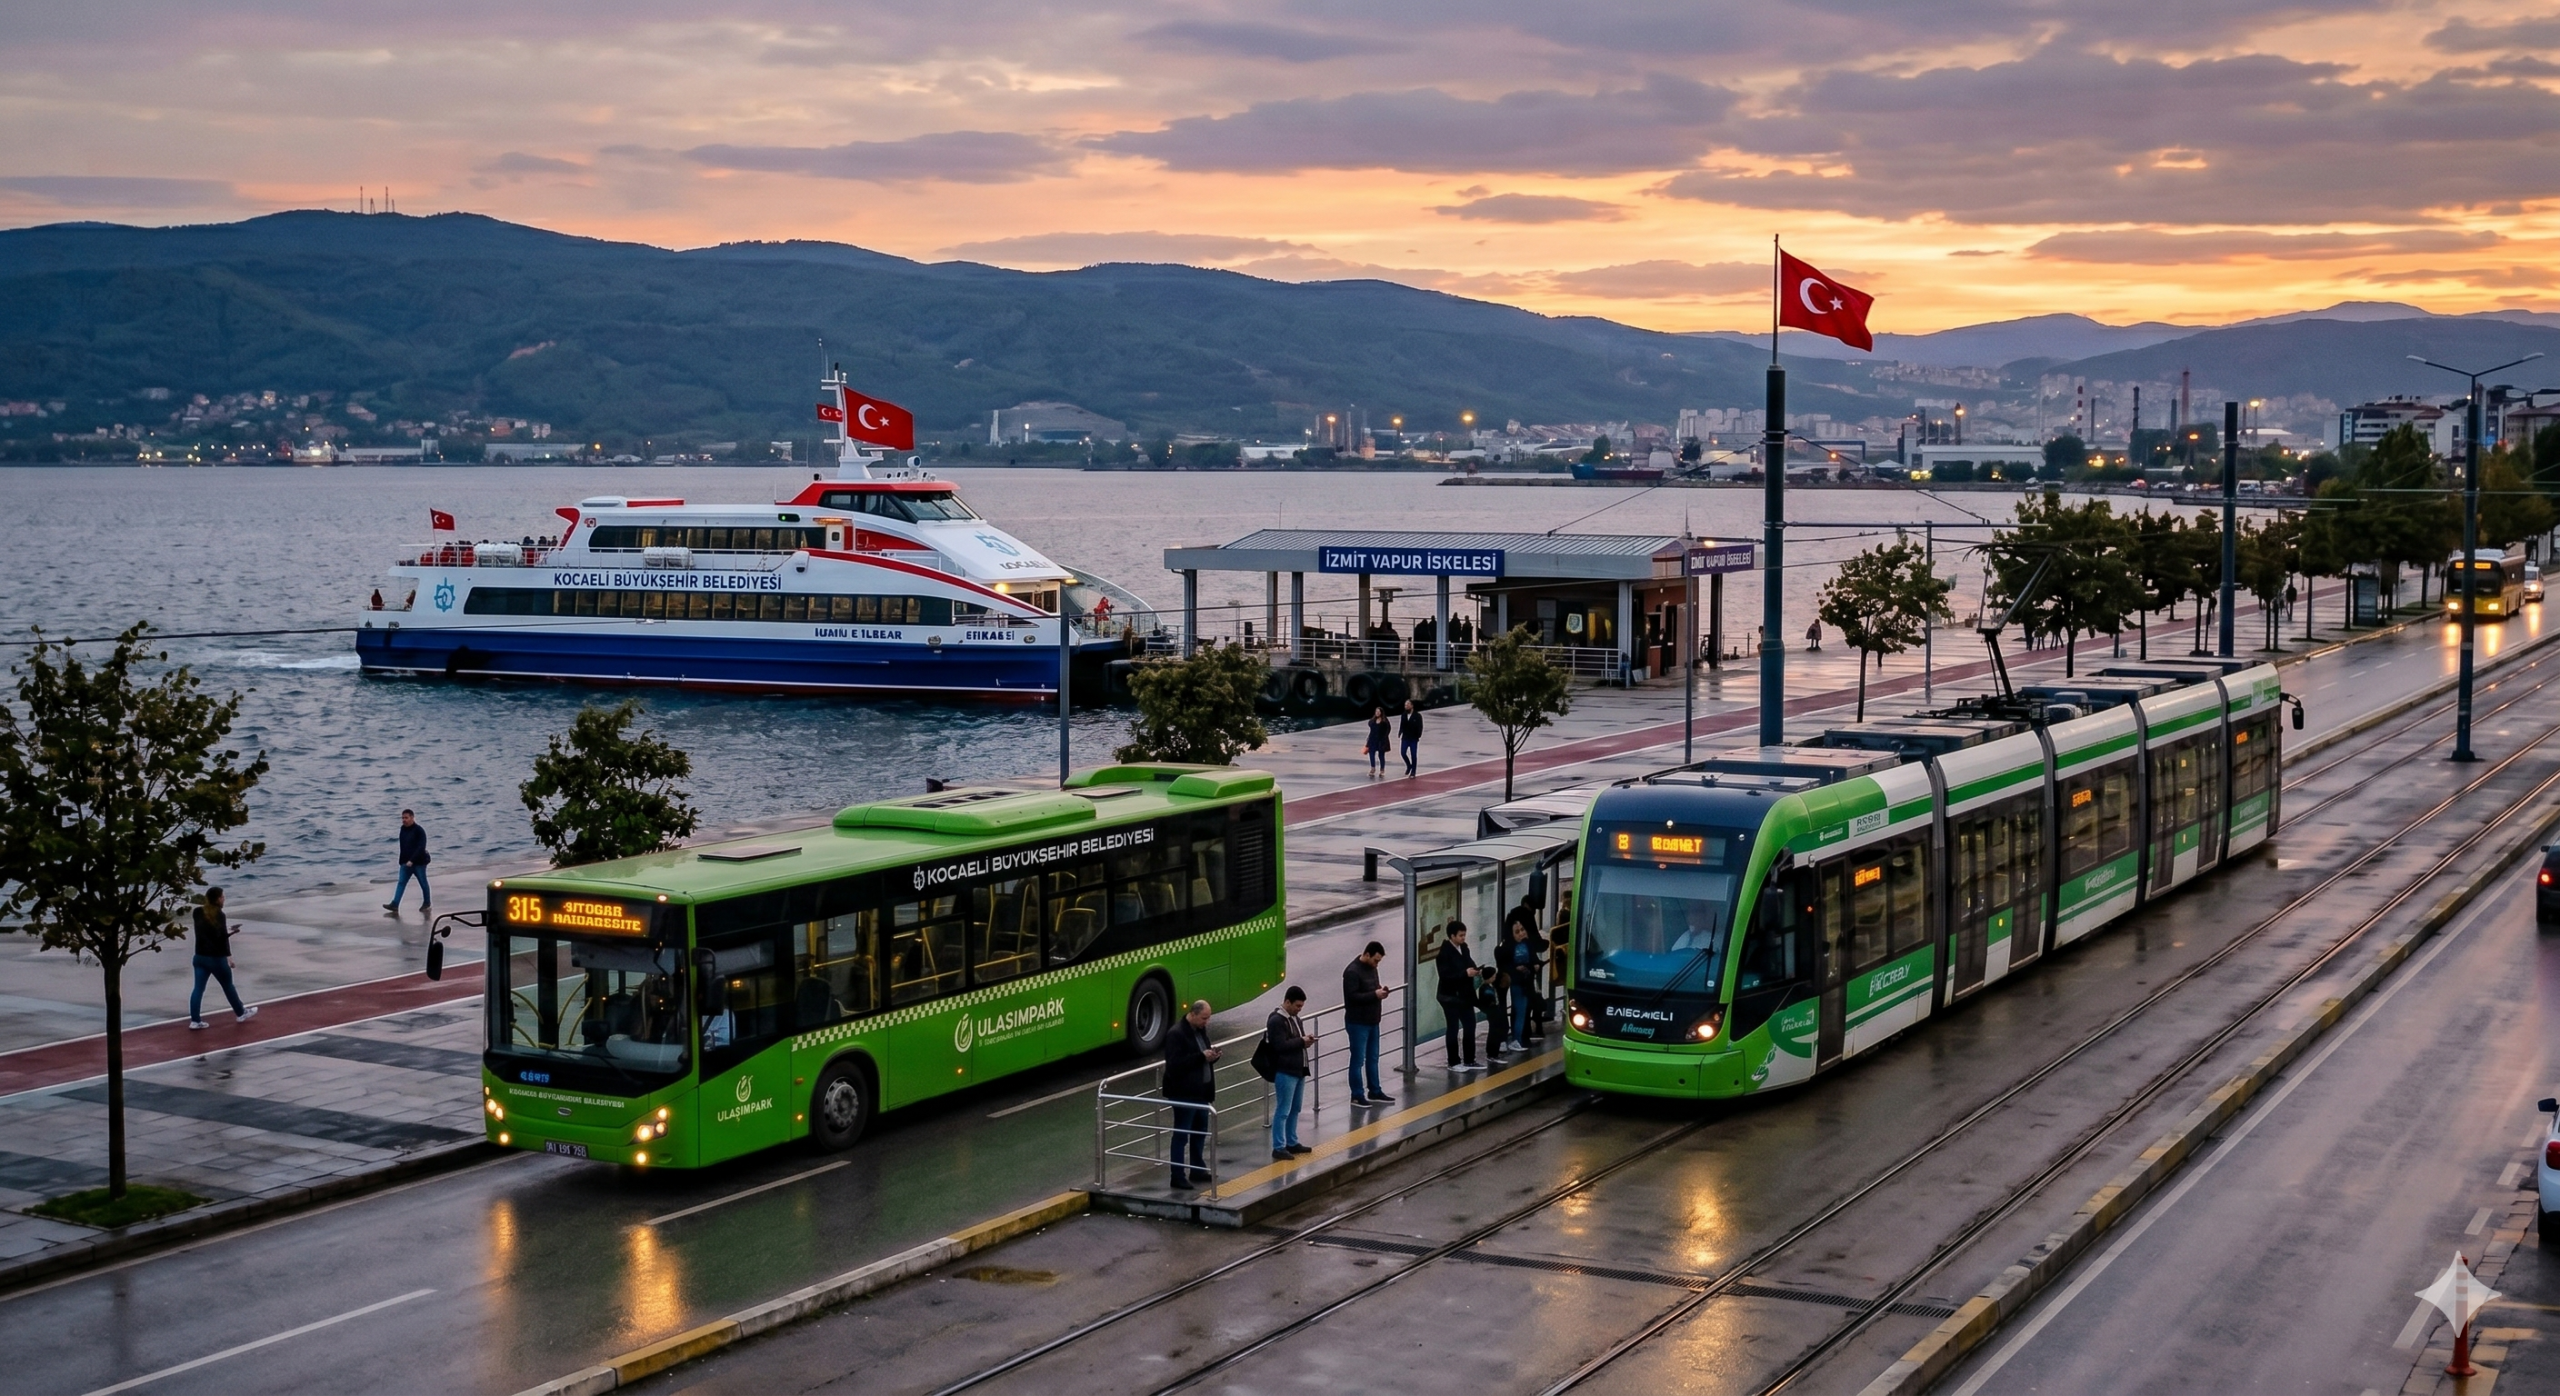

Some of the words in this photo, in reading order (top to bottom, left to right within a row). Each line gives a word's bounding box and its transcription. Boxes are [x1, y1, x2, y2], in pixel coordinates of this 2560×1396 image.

[1326, 550, 1367, 568] İZMİT
[1371, 553, 1423, 569] VAPUR
[1427, 552, 1497, 571] İSKELESİ
[554, 571, 610, 586] KOCAELİ
[614, 571, 698, 589] BÜYÜKŞEHİR
[703, 573, 782, 590] BELEDİYESİ
[927, 856, 989, 885] KOCAELİ
[509, 896, 541, 922] 315
[717, 1097, 773, 1122] ULAŞIMPARK
